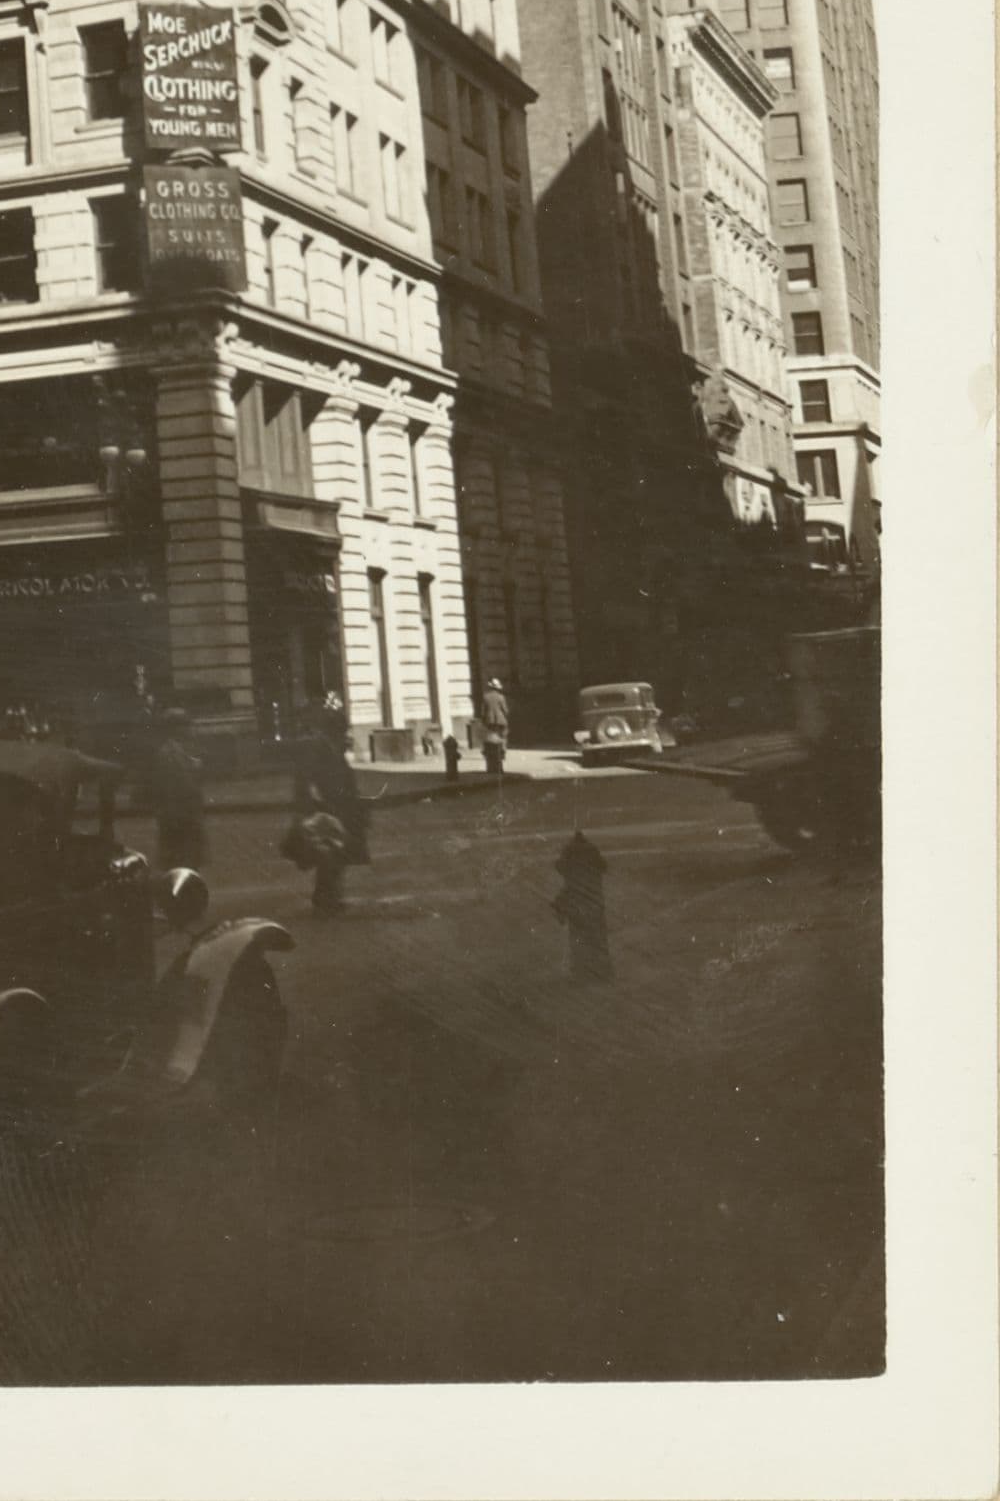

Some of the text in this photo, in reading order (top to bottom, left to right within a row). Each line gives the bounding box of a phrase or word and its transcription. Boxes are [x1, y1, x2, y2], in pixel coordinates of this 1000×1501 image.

[147, 11, 187, 34] MOE
[143, 20, 232, 71] SERCHUCK
[143, 74, 237, 103] CLOTHING
[178, 104, 207, 117] FOR
[148, 118, 237, 139] YOUNG MEN
[156, 180, 230, 198] GROSS
[149, 202, 217, 220] CLOTHING
[168, 229, 226, 244] SUITS
